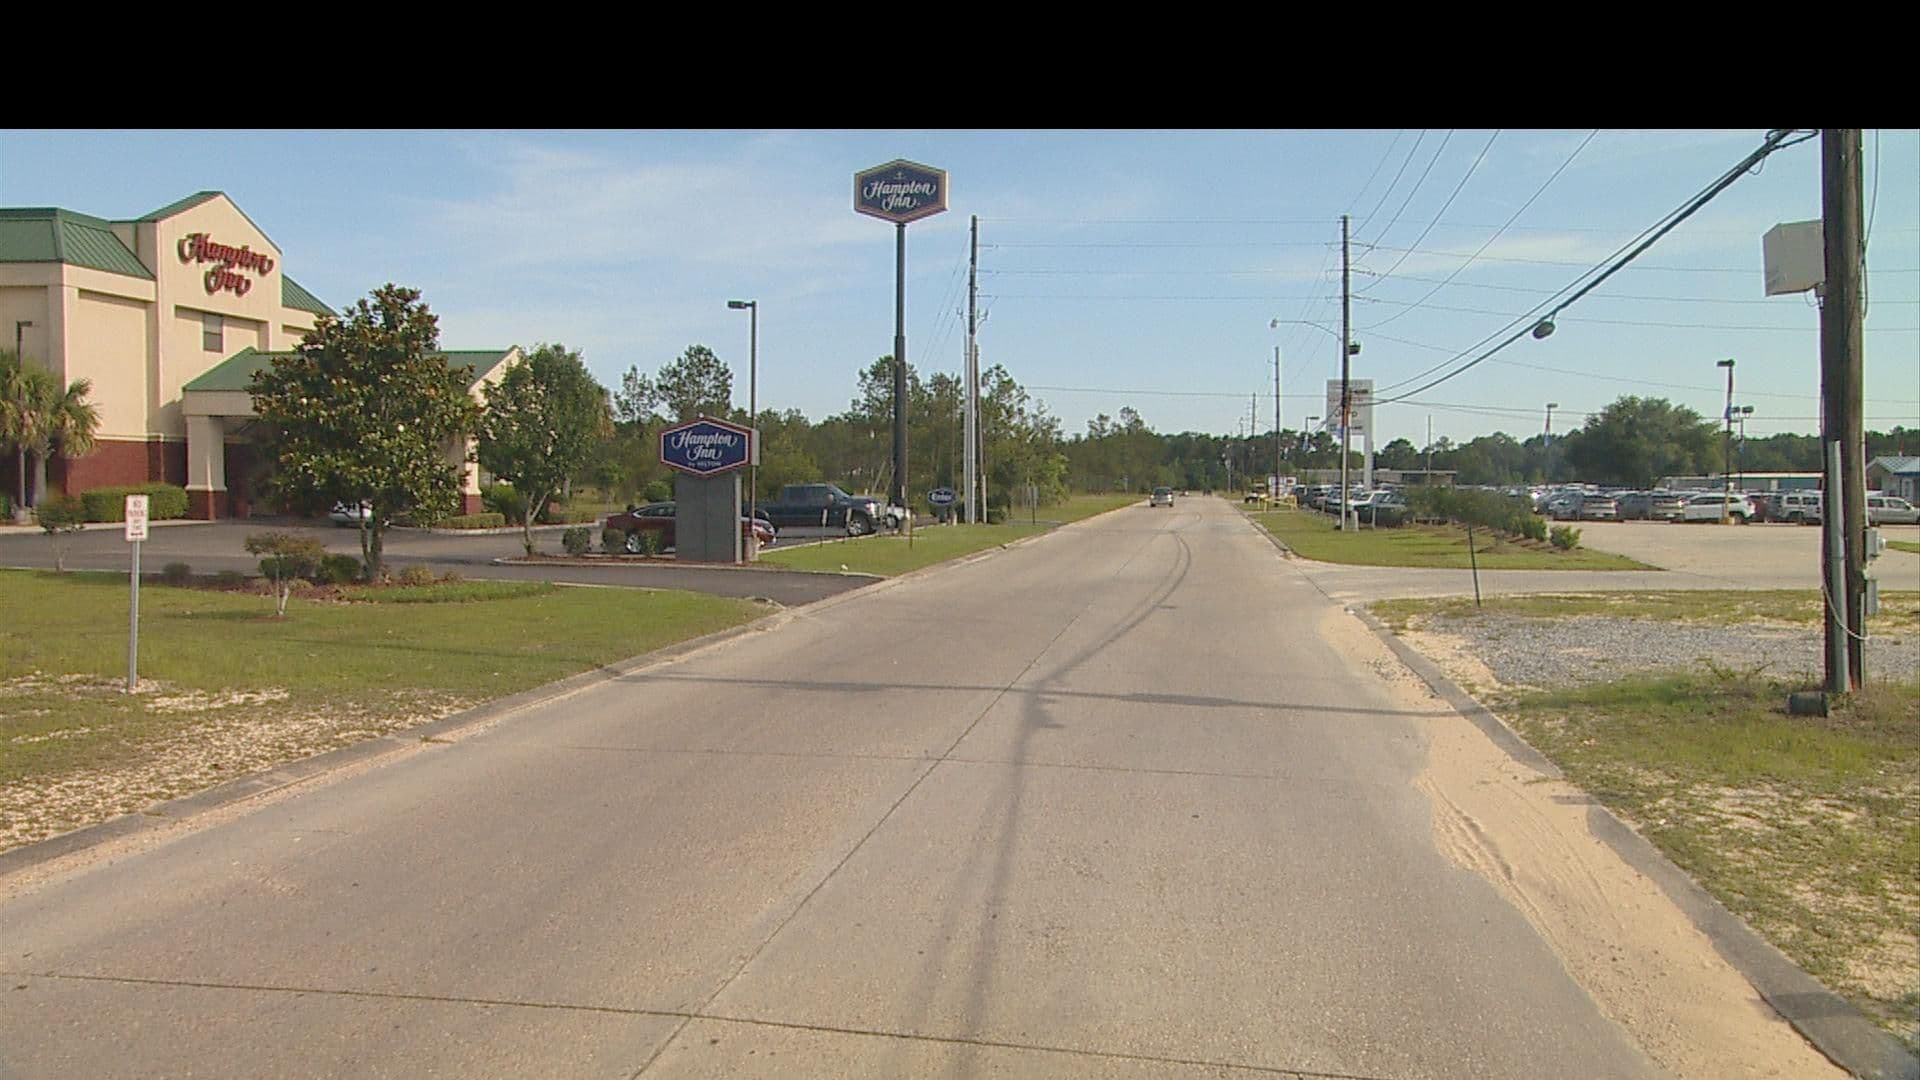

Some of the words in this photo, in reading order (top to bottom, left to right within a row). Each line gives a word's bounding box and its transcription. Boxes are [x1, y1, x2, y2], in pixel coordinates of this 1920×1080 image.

[863, 181, 936, 199] Hampton
[882, 194, 917, 211] Inn
[177, 233, 274, 276] Hampton
[204, 265, 252, 297] Inn
[671, 430, 738, 448] Hampton
[686, 445, 722, 460] Inn
